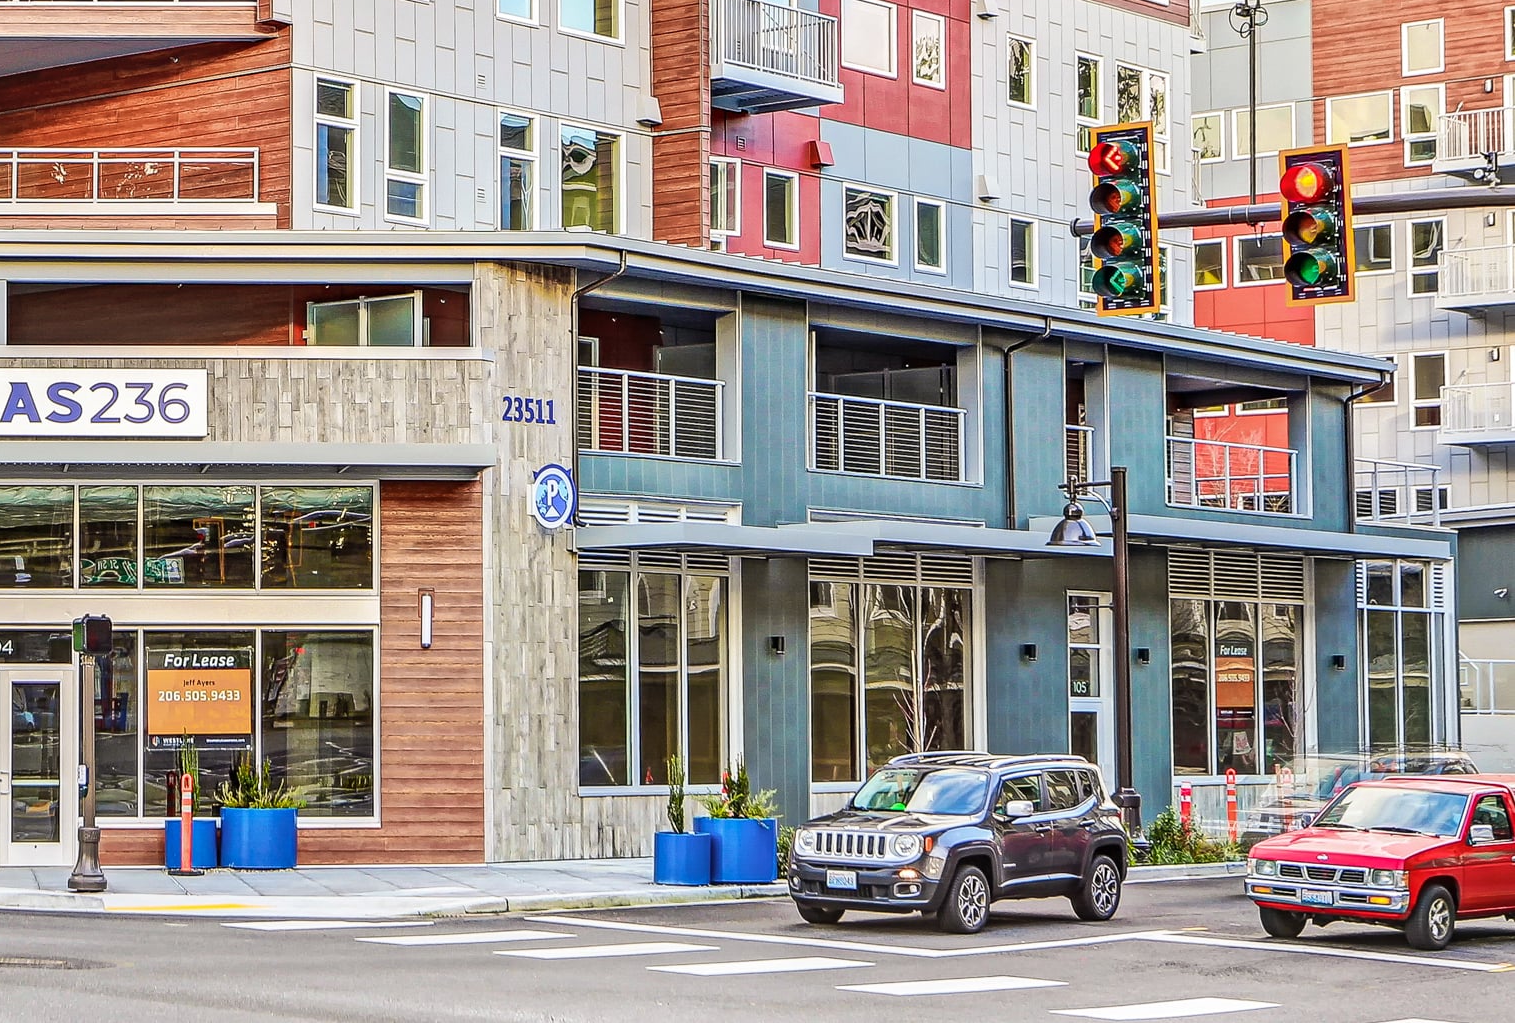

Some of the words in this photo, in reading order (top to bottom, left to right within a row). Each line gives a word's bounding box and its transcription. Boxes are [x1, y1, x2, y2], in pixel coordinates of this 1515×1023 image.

[502, 396, 556, 425] 23511
[546, 479, 559, 506] P
[1219, 645, 1230, 656] For
[1230, 645, 1248, 656] Lease
[164, 653, 190, 668] For
[192, 653, 235, 668] Lease
[183, 679, 195, 687] Jeff
[196, 679, 216, 687] Ayers
[1073, 681, 1087, 694] 105
[157, 690, 241, 702] 206.505.9433
